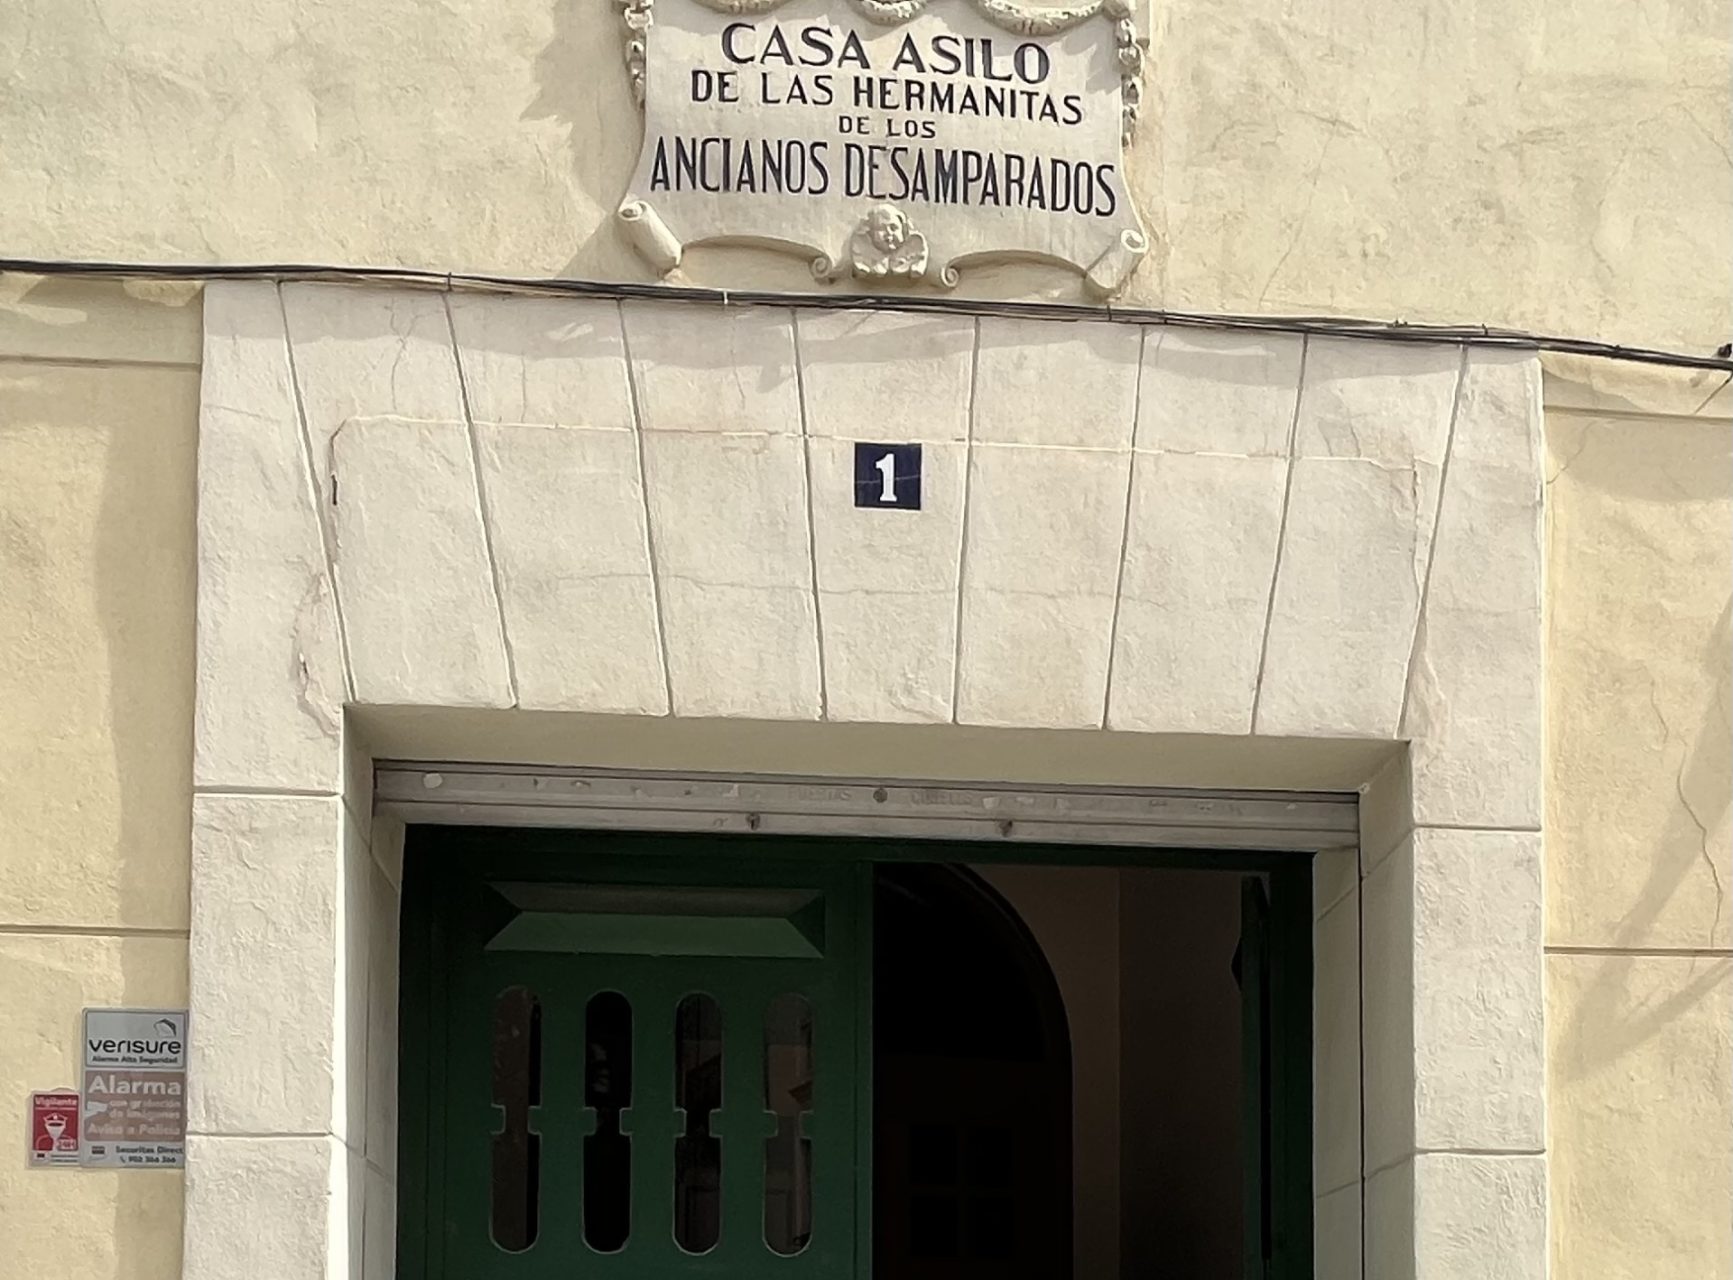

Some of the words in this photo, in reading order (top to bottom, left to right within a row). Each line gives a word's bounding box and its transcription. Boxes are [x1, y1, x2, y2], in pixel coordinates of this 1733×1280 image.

[721, 22, 871, 69] CASA
[892, 32, 1050, 84] ASILO
[691, 69, 739, 102] DE
[761, 72, 833, 105] LAS
[854, 76, 1082, 125] HERMANITAS
[838, 115, 870, 135] DE
[887, 118, 936, 138] LOS
[650, 136, 829, 195] ANCIANOS
[844, 142, 1116, 217] DESAMPARADOS
[875, 453, 898, 502] 1
[88, 1039, 181, 1055] verisure
[88, 1074, 181, 1096] Alarma
